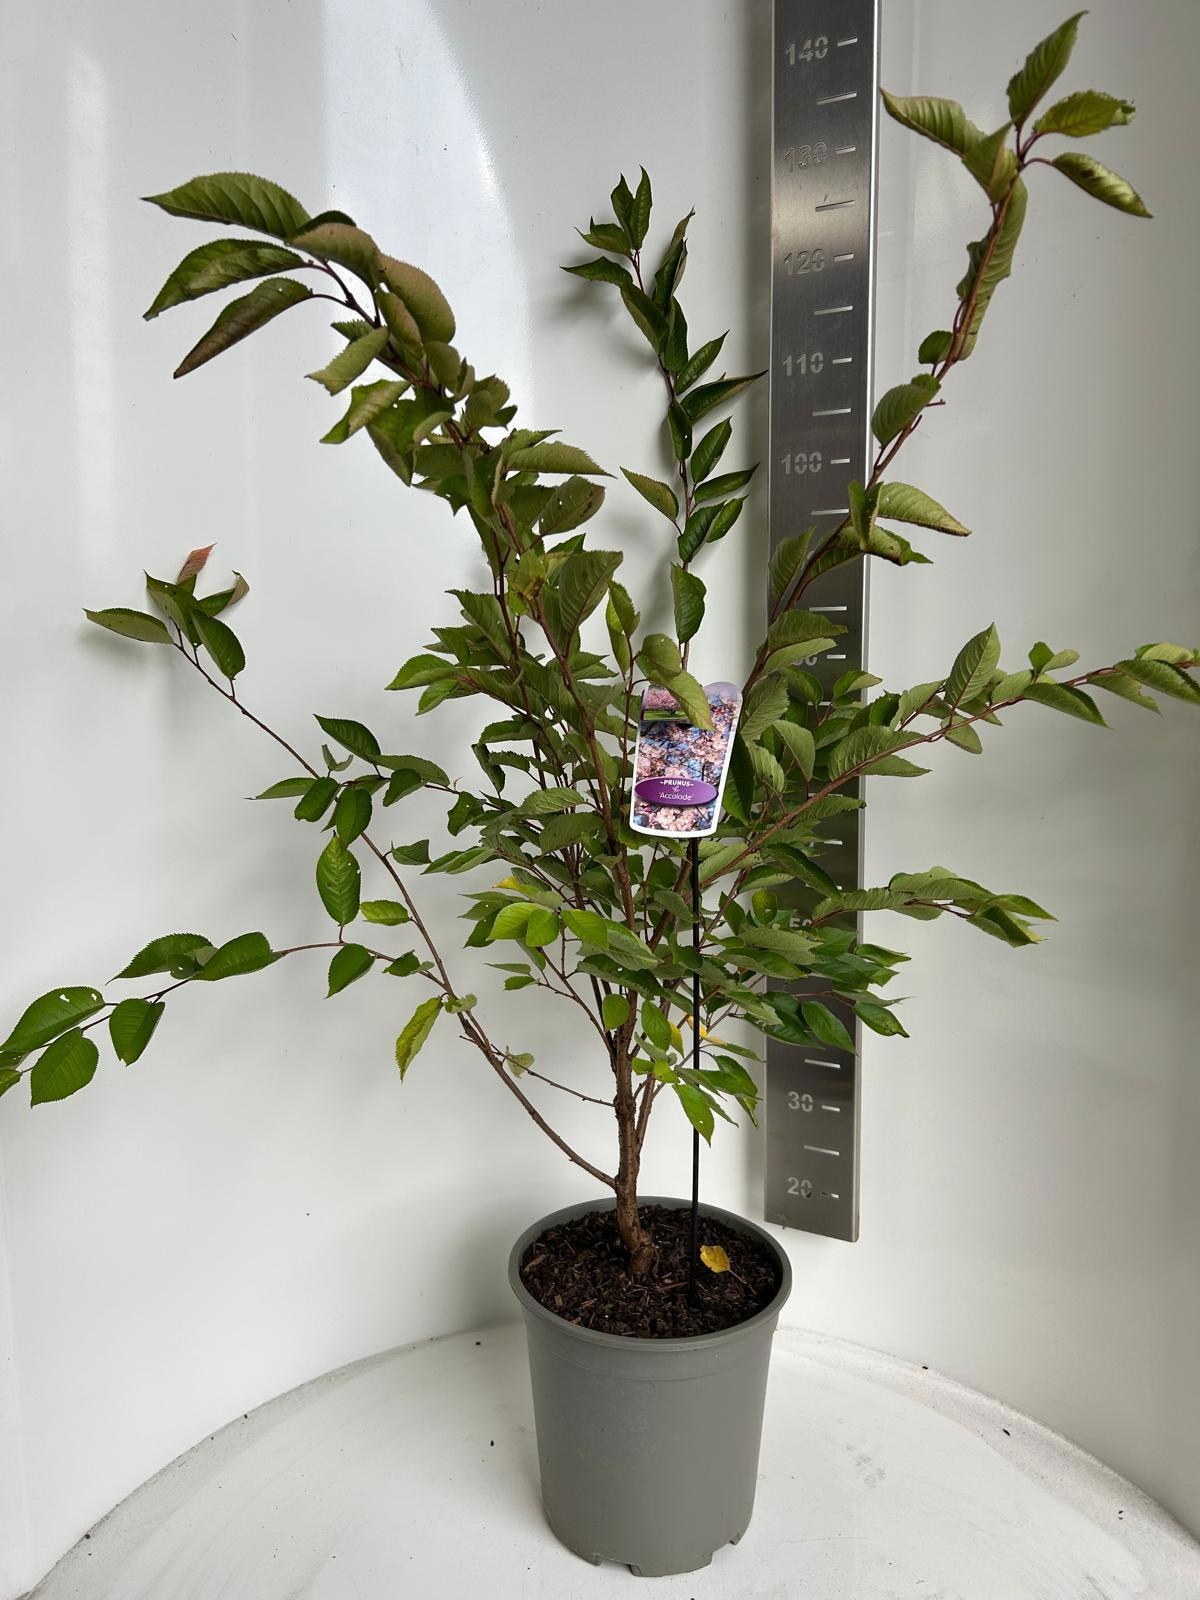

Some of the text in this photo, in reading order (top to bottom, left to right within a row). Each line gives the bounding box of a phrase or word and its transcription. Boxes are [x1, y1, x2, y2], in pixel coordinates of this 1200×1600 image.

[785, 35, 829, 65] 140
[783, 141, 827, 173] 130
[783, 248, 825, 276] 120
[782, 352, 824, 376] 110
[781, 452, 822, 475] 100
[788, 1091, 813, 1112] 30
[787, 1176, 812, 1198] 20
